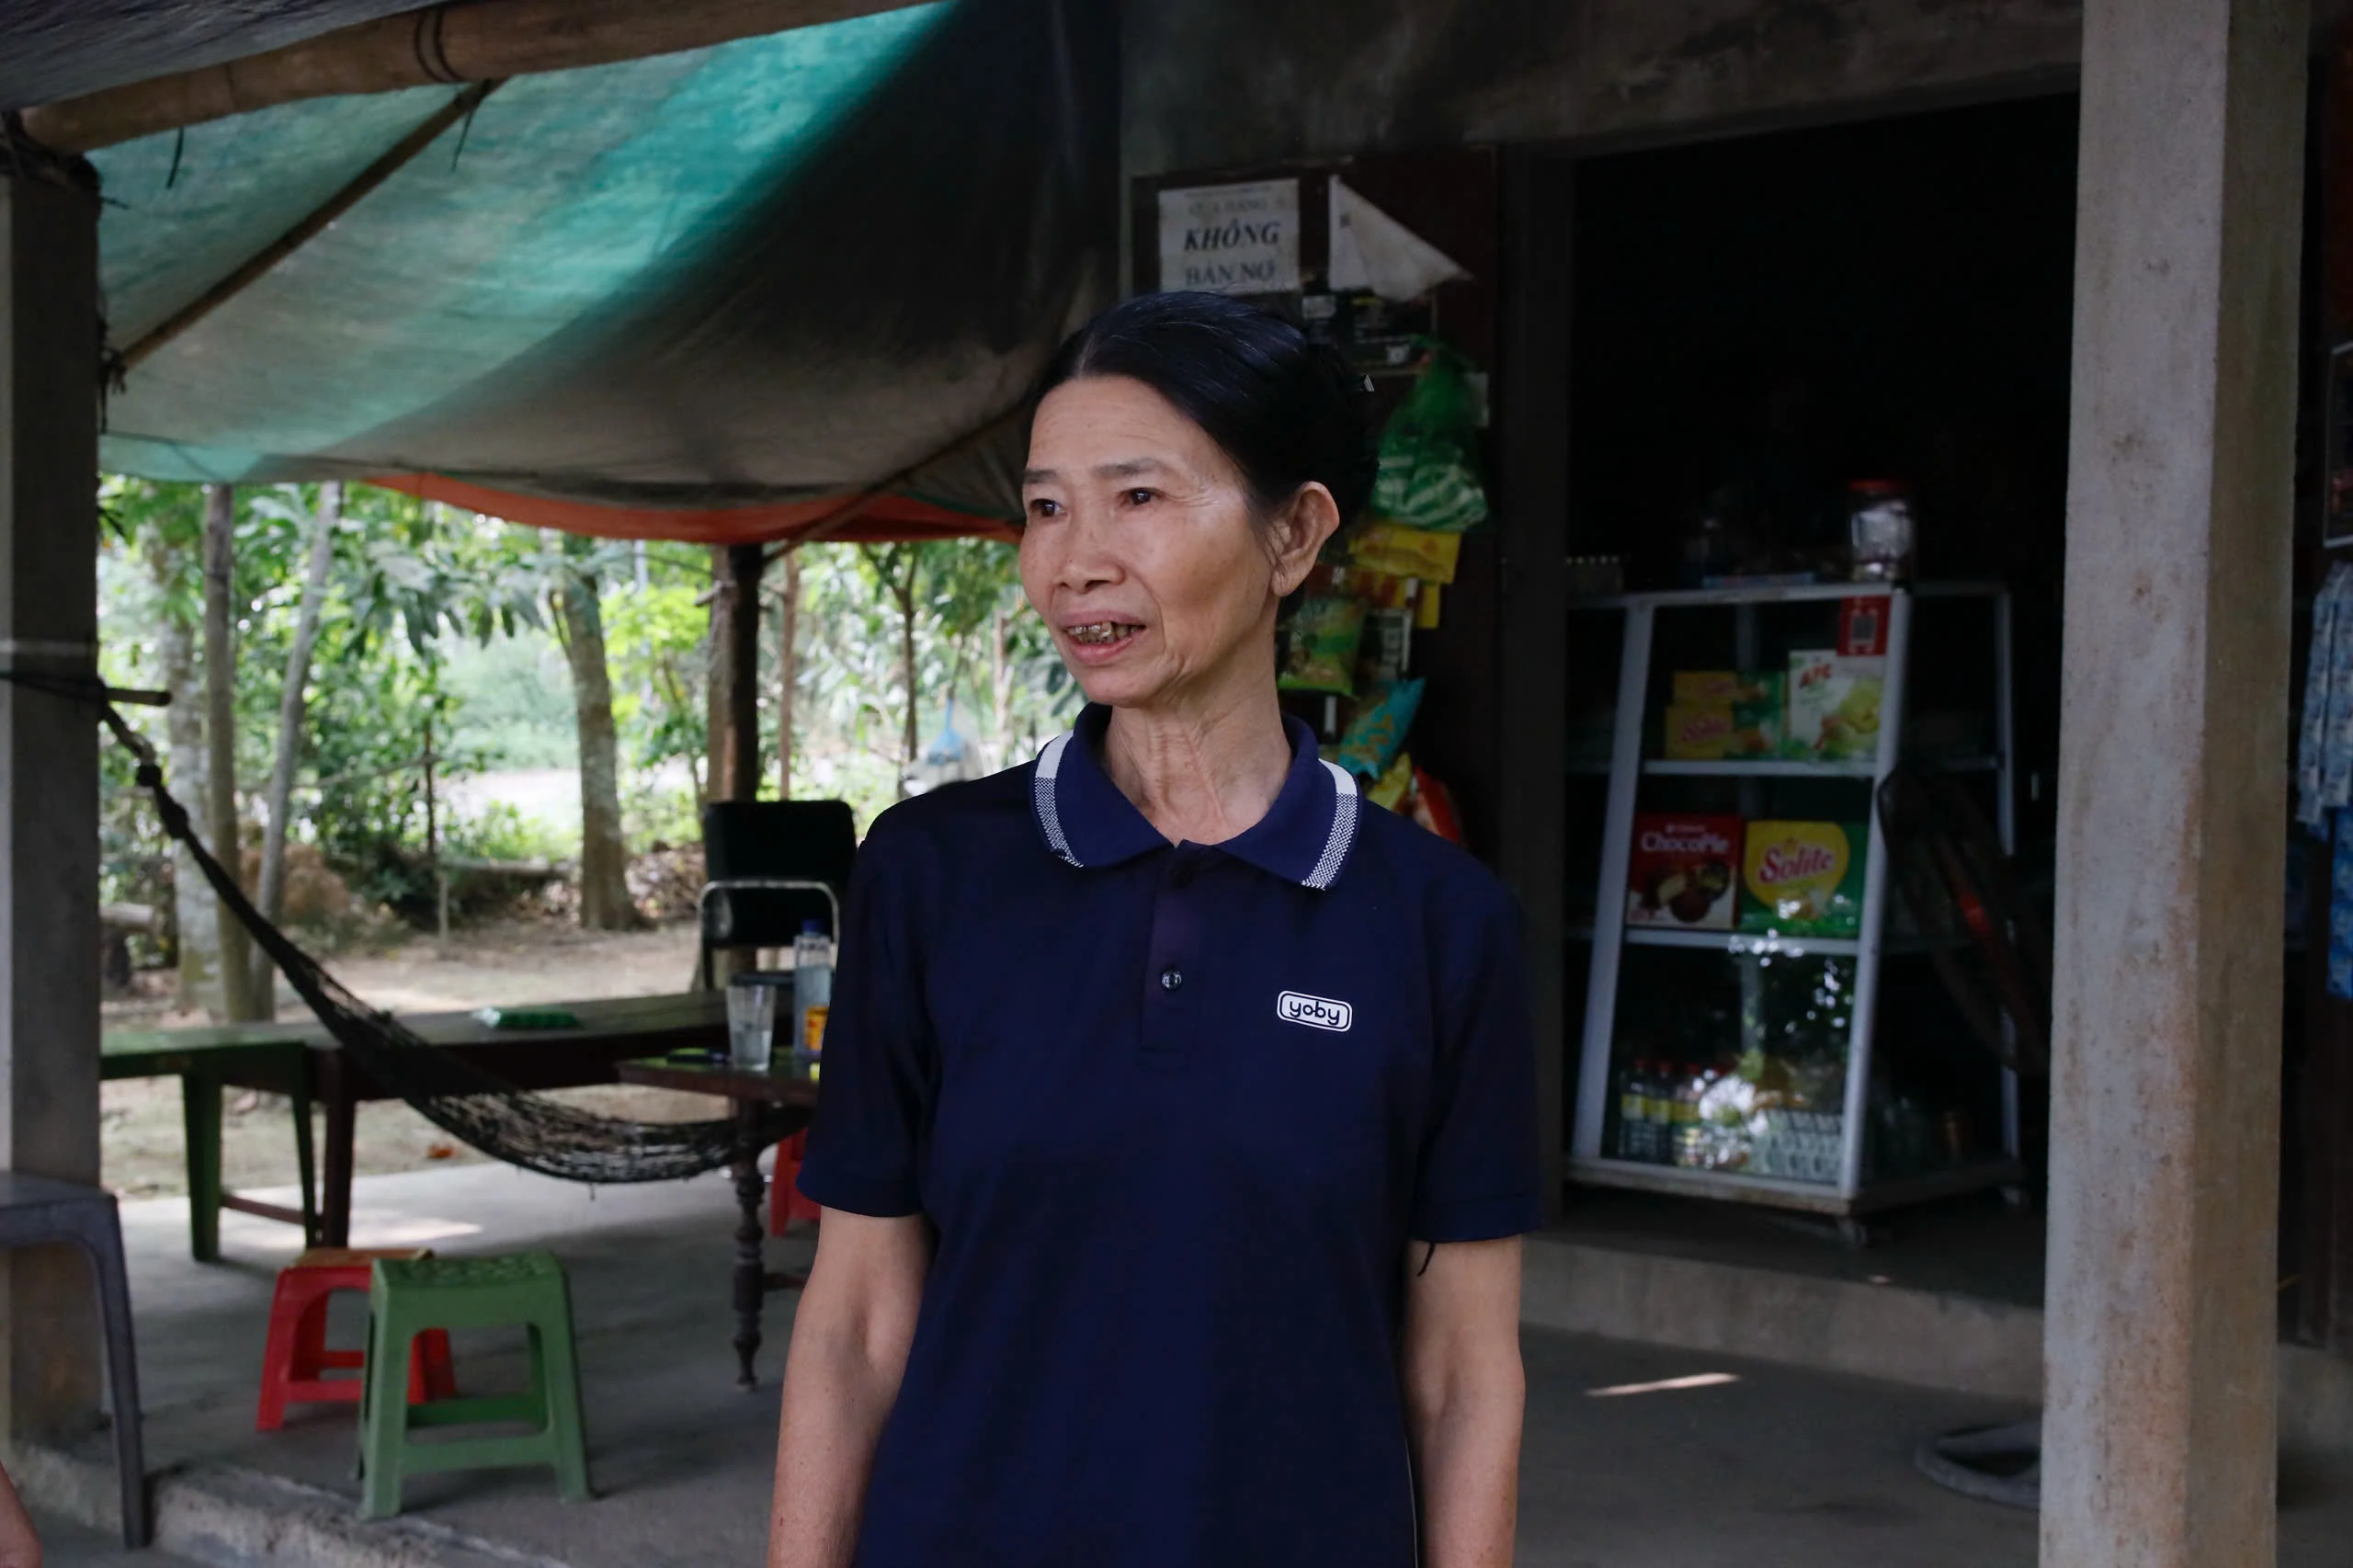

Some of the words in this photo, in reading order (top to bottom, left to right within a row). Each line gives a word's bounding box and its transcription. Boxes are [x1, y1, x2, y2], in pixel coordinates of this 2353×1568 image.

[1185, 218, 1280, 250] KHÔNG
[1759, 844, 1835, 883] Solite
[1289, 1000, 1341, 1026] yoby
